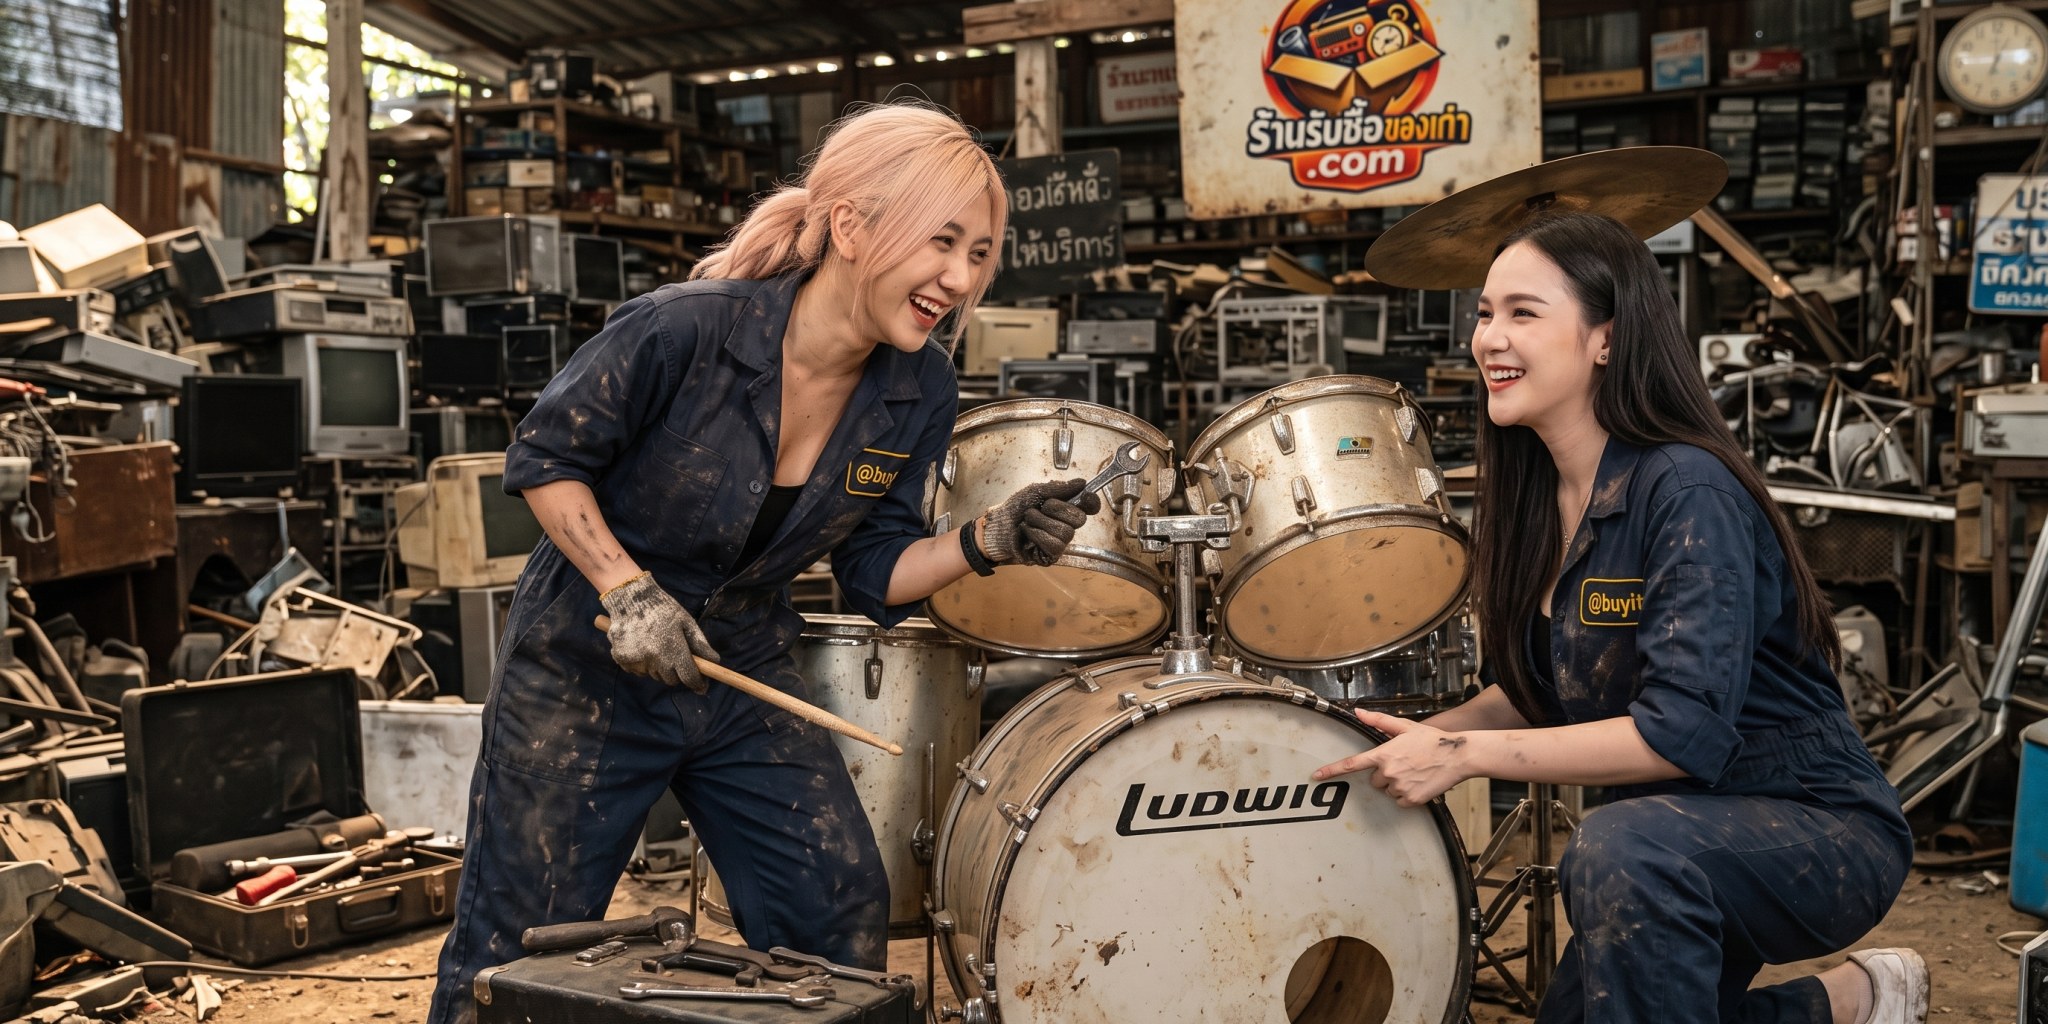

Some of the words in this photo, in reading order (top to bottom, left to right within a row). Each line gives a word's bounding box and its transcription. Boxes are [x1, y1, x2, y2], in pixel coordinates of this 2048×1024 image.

[1249, 98, 1470, 154] ร้านรับซื้อของเก่า
[1306, 149, 1405, 178] .com
[1588, 592, 1644, 618] @buyit
